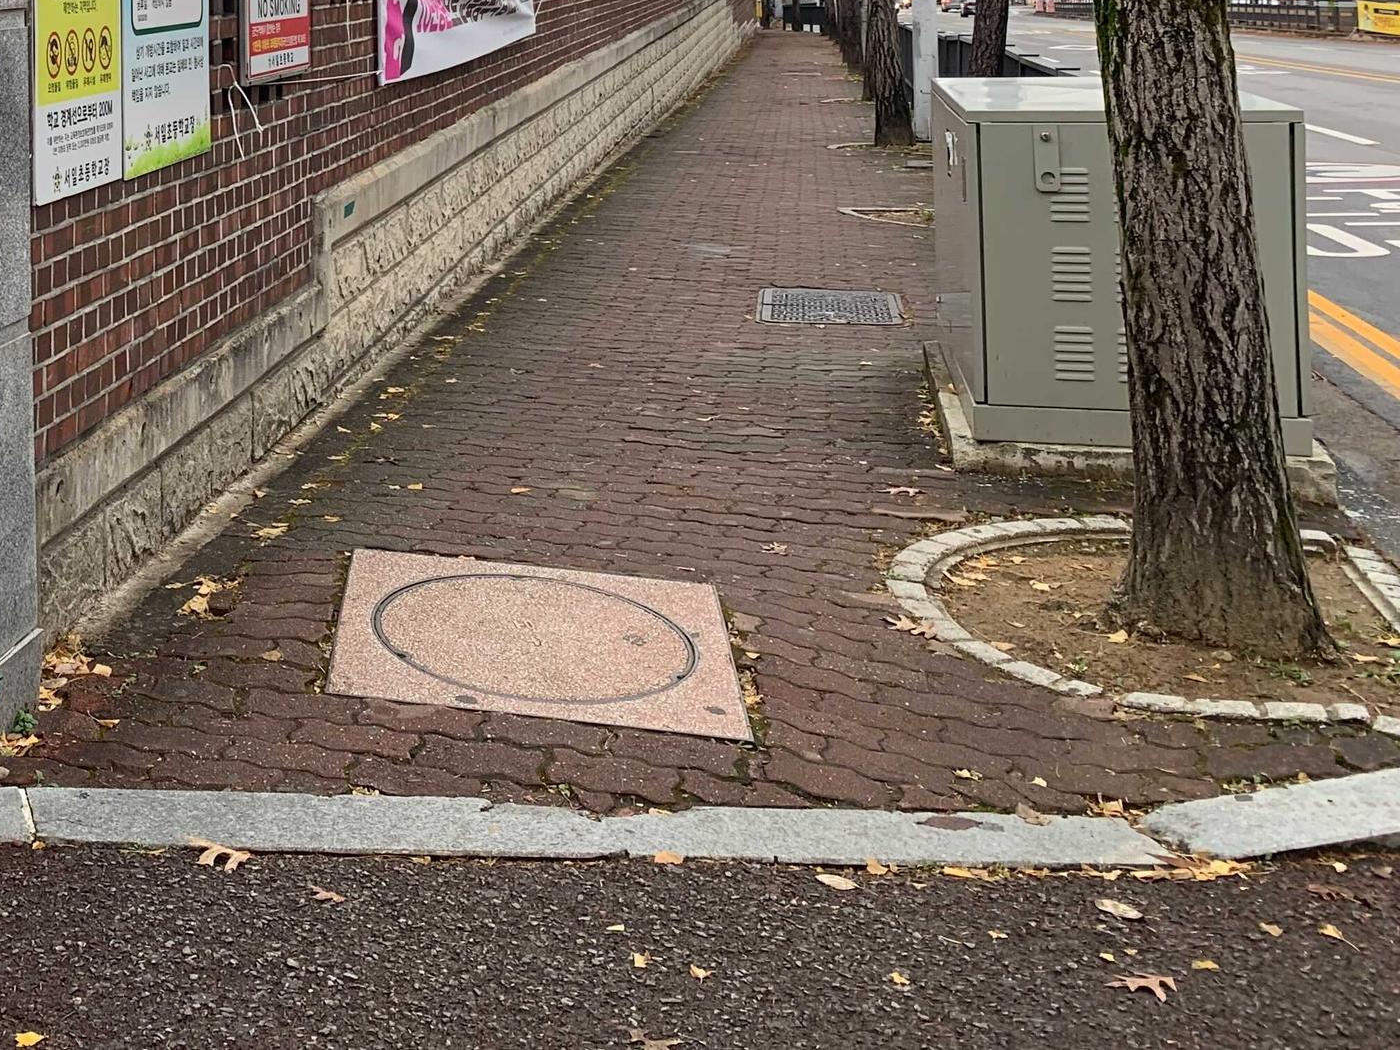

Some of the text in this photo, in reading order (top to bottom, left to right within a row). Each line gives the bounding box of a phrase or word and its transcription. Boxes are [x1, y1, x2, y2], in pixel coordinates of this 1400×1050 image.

[46, 99, 113, 130] 학교 경계선으로부터 200M
[154, 115, 195, 144] 서일초등학교장
[64, 156, 110, 188] 서일초등학교장
